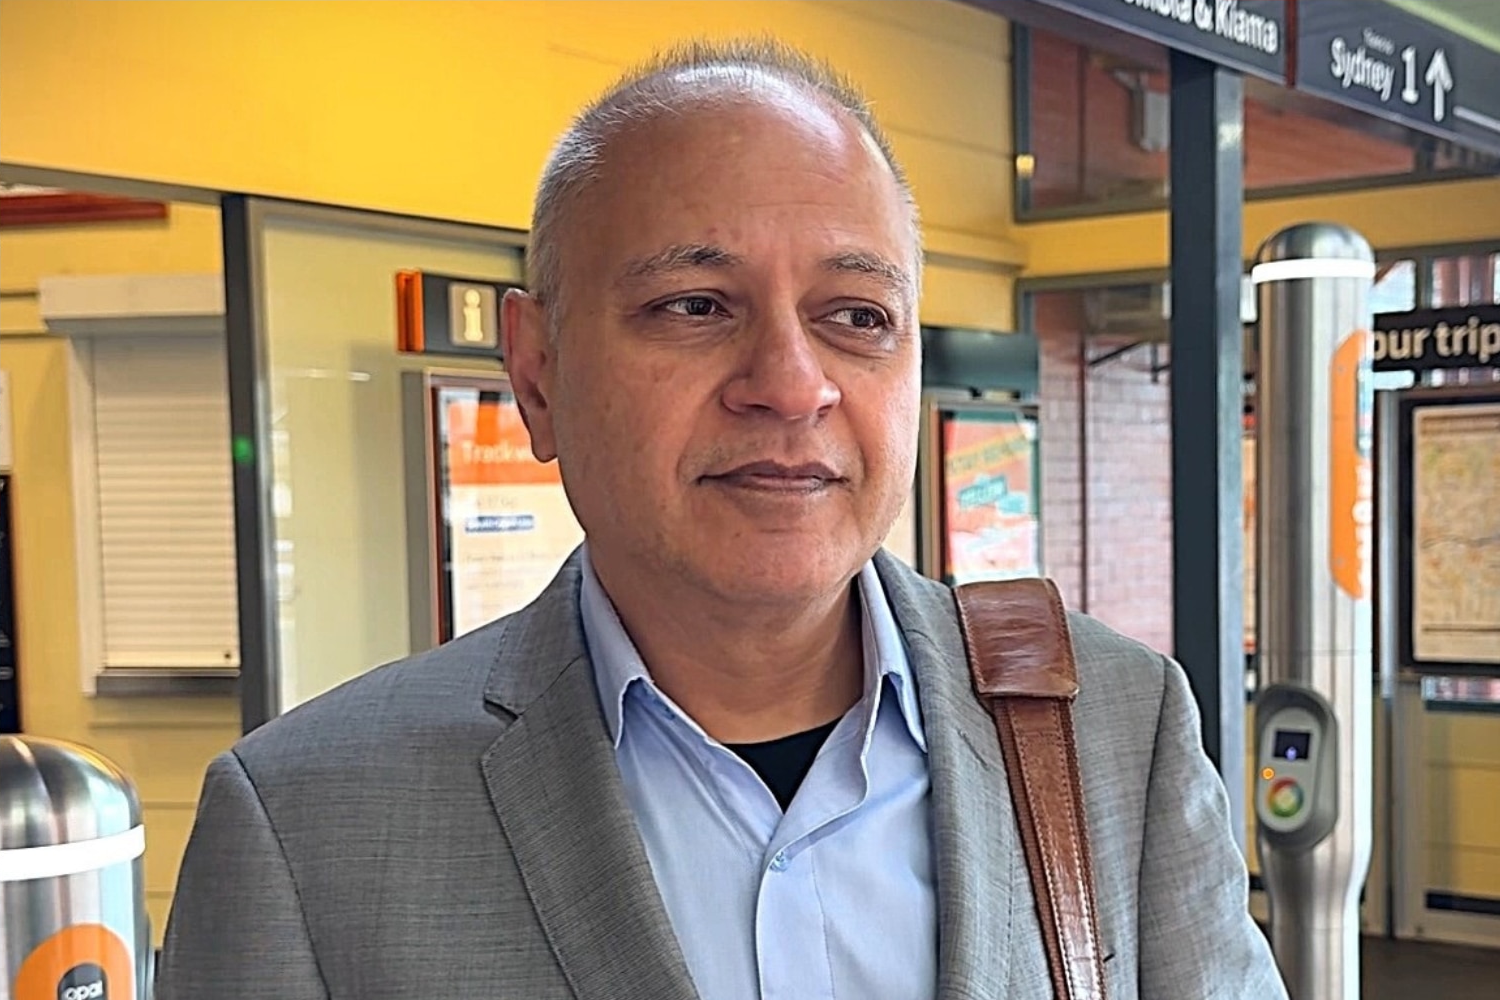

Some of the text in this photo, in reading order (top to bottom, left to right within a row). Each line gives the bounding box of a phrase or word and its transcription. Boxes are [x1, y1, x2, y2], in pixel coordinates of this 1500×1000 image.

[1215, 0, 1279, 54] Kiama
[1330, 37, 1395, 102] Sydney
[1401, 45, 1419, 104] 1
[1433, 315, 1500, 364] trip
